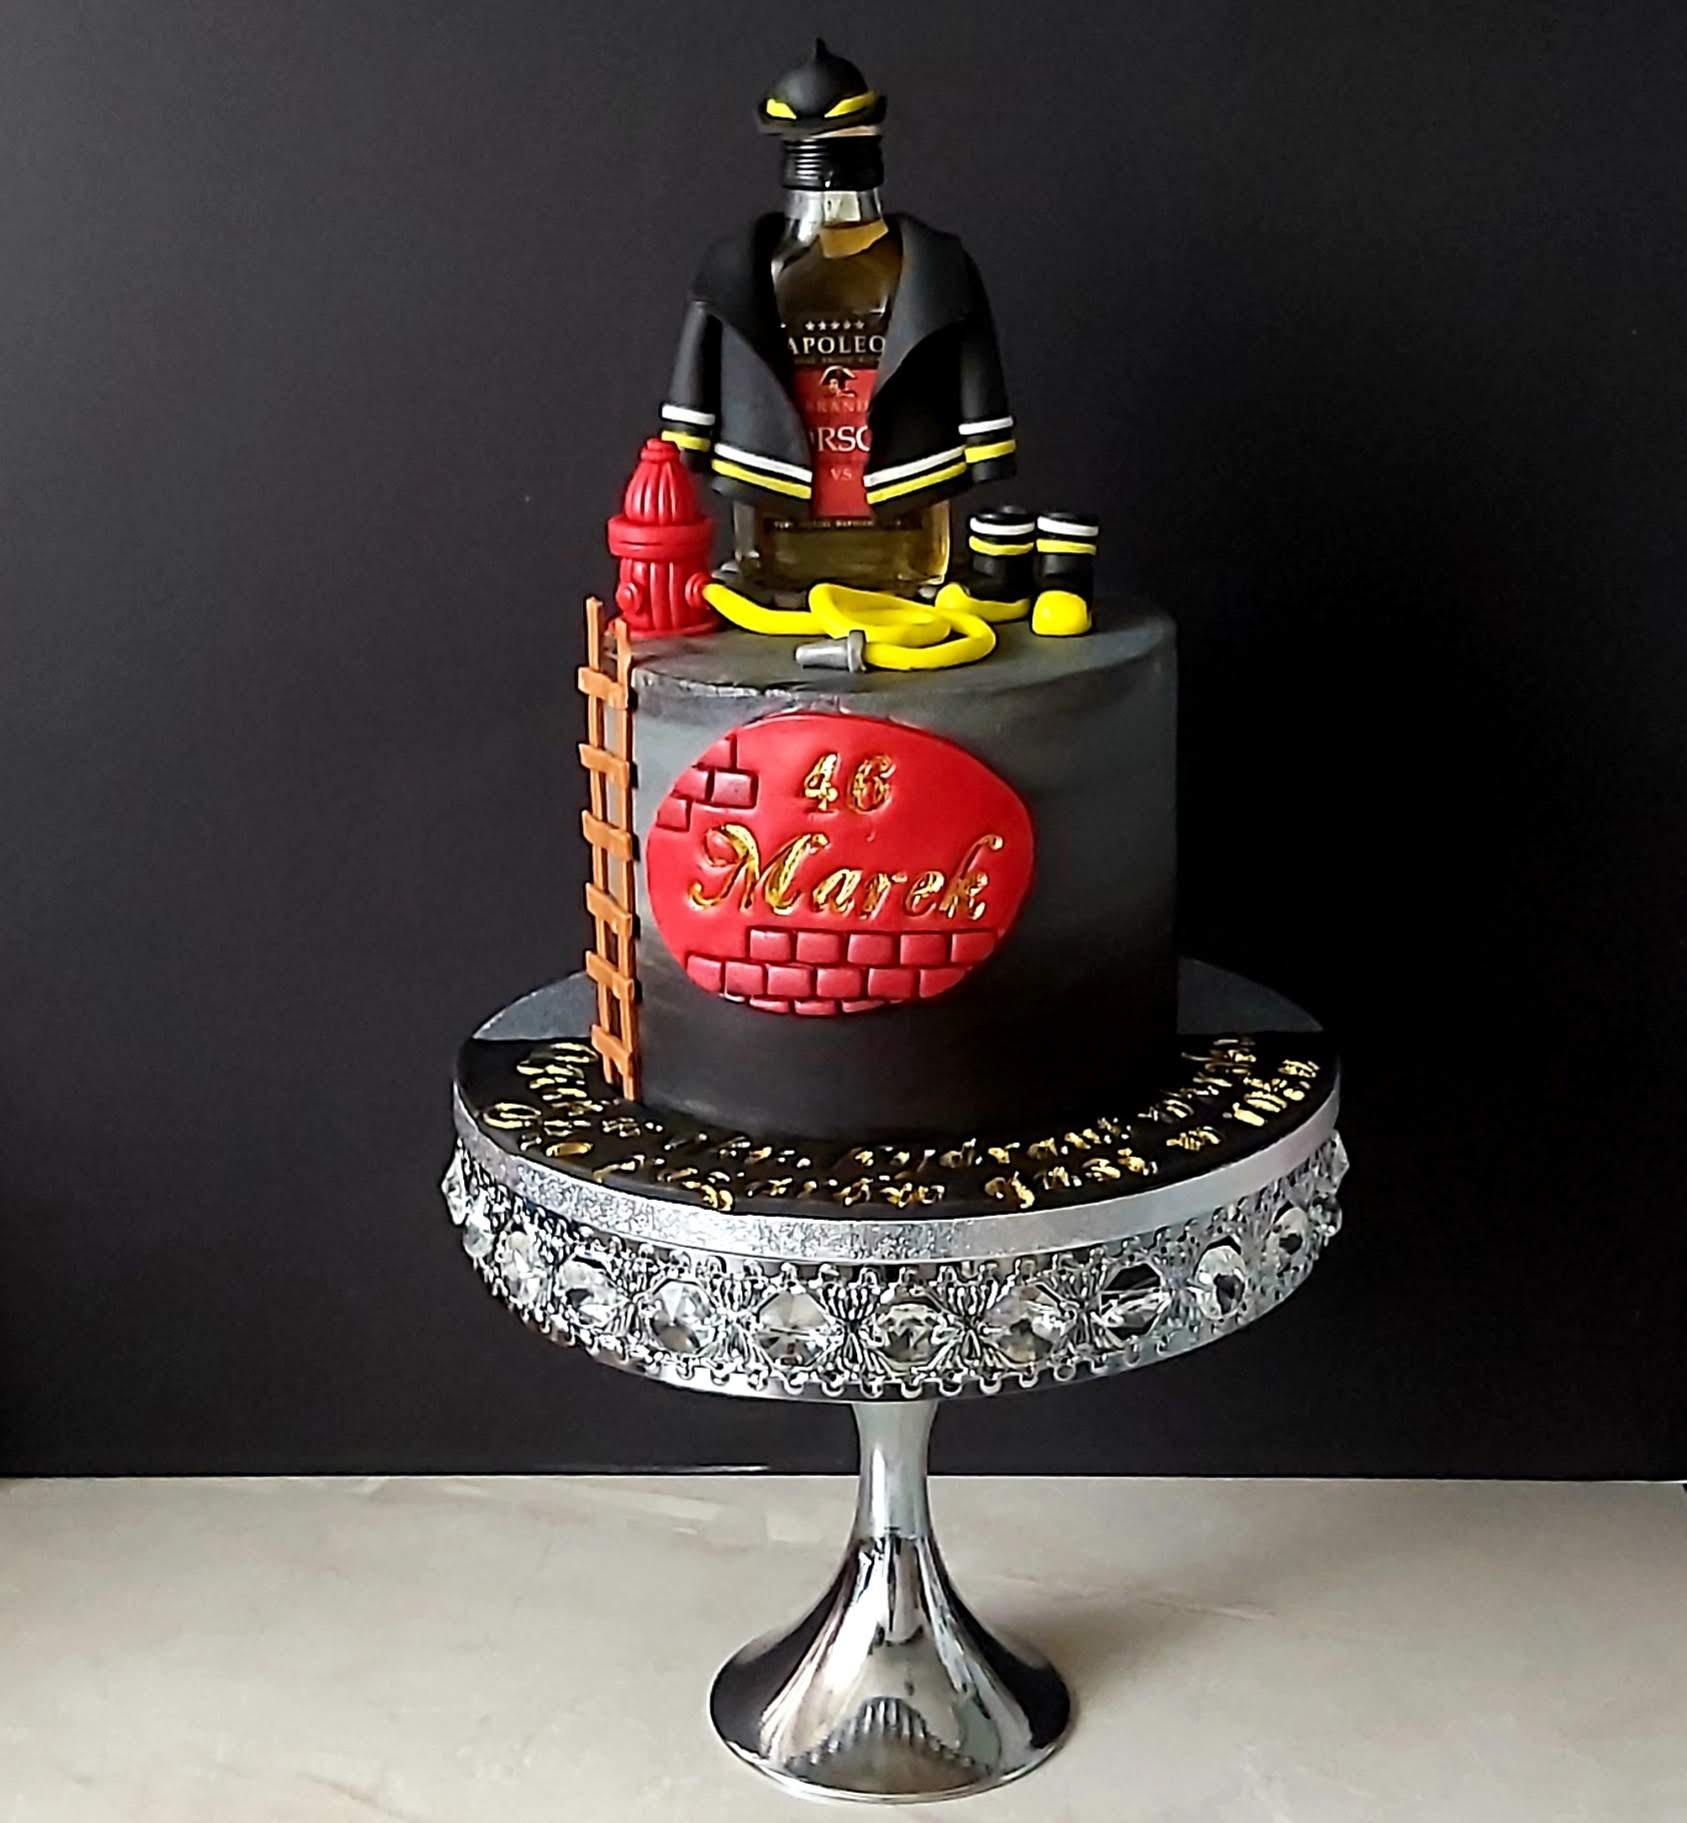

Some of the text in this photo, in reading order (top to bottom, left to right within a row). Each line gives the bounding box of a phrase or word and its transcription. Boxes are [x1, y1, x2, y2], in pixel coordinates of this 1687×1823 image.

[830, 467, 853, 481] VS
[804, 753, 894, 814] 46
[688, 824, 1003, 919] Marek
